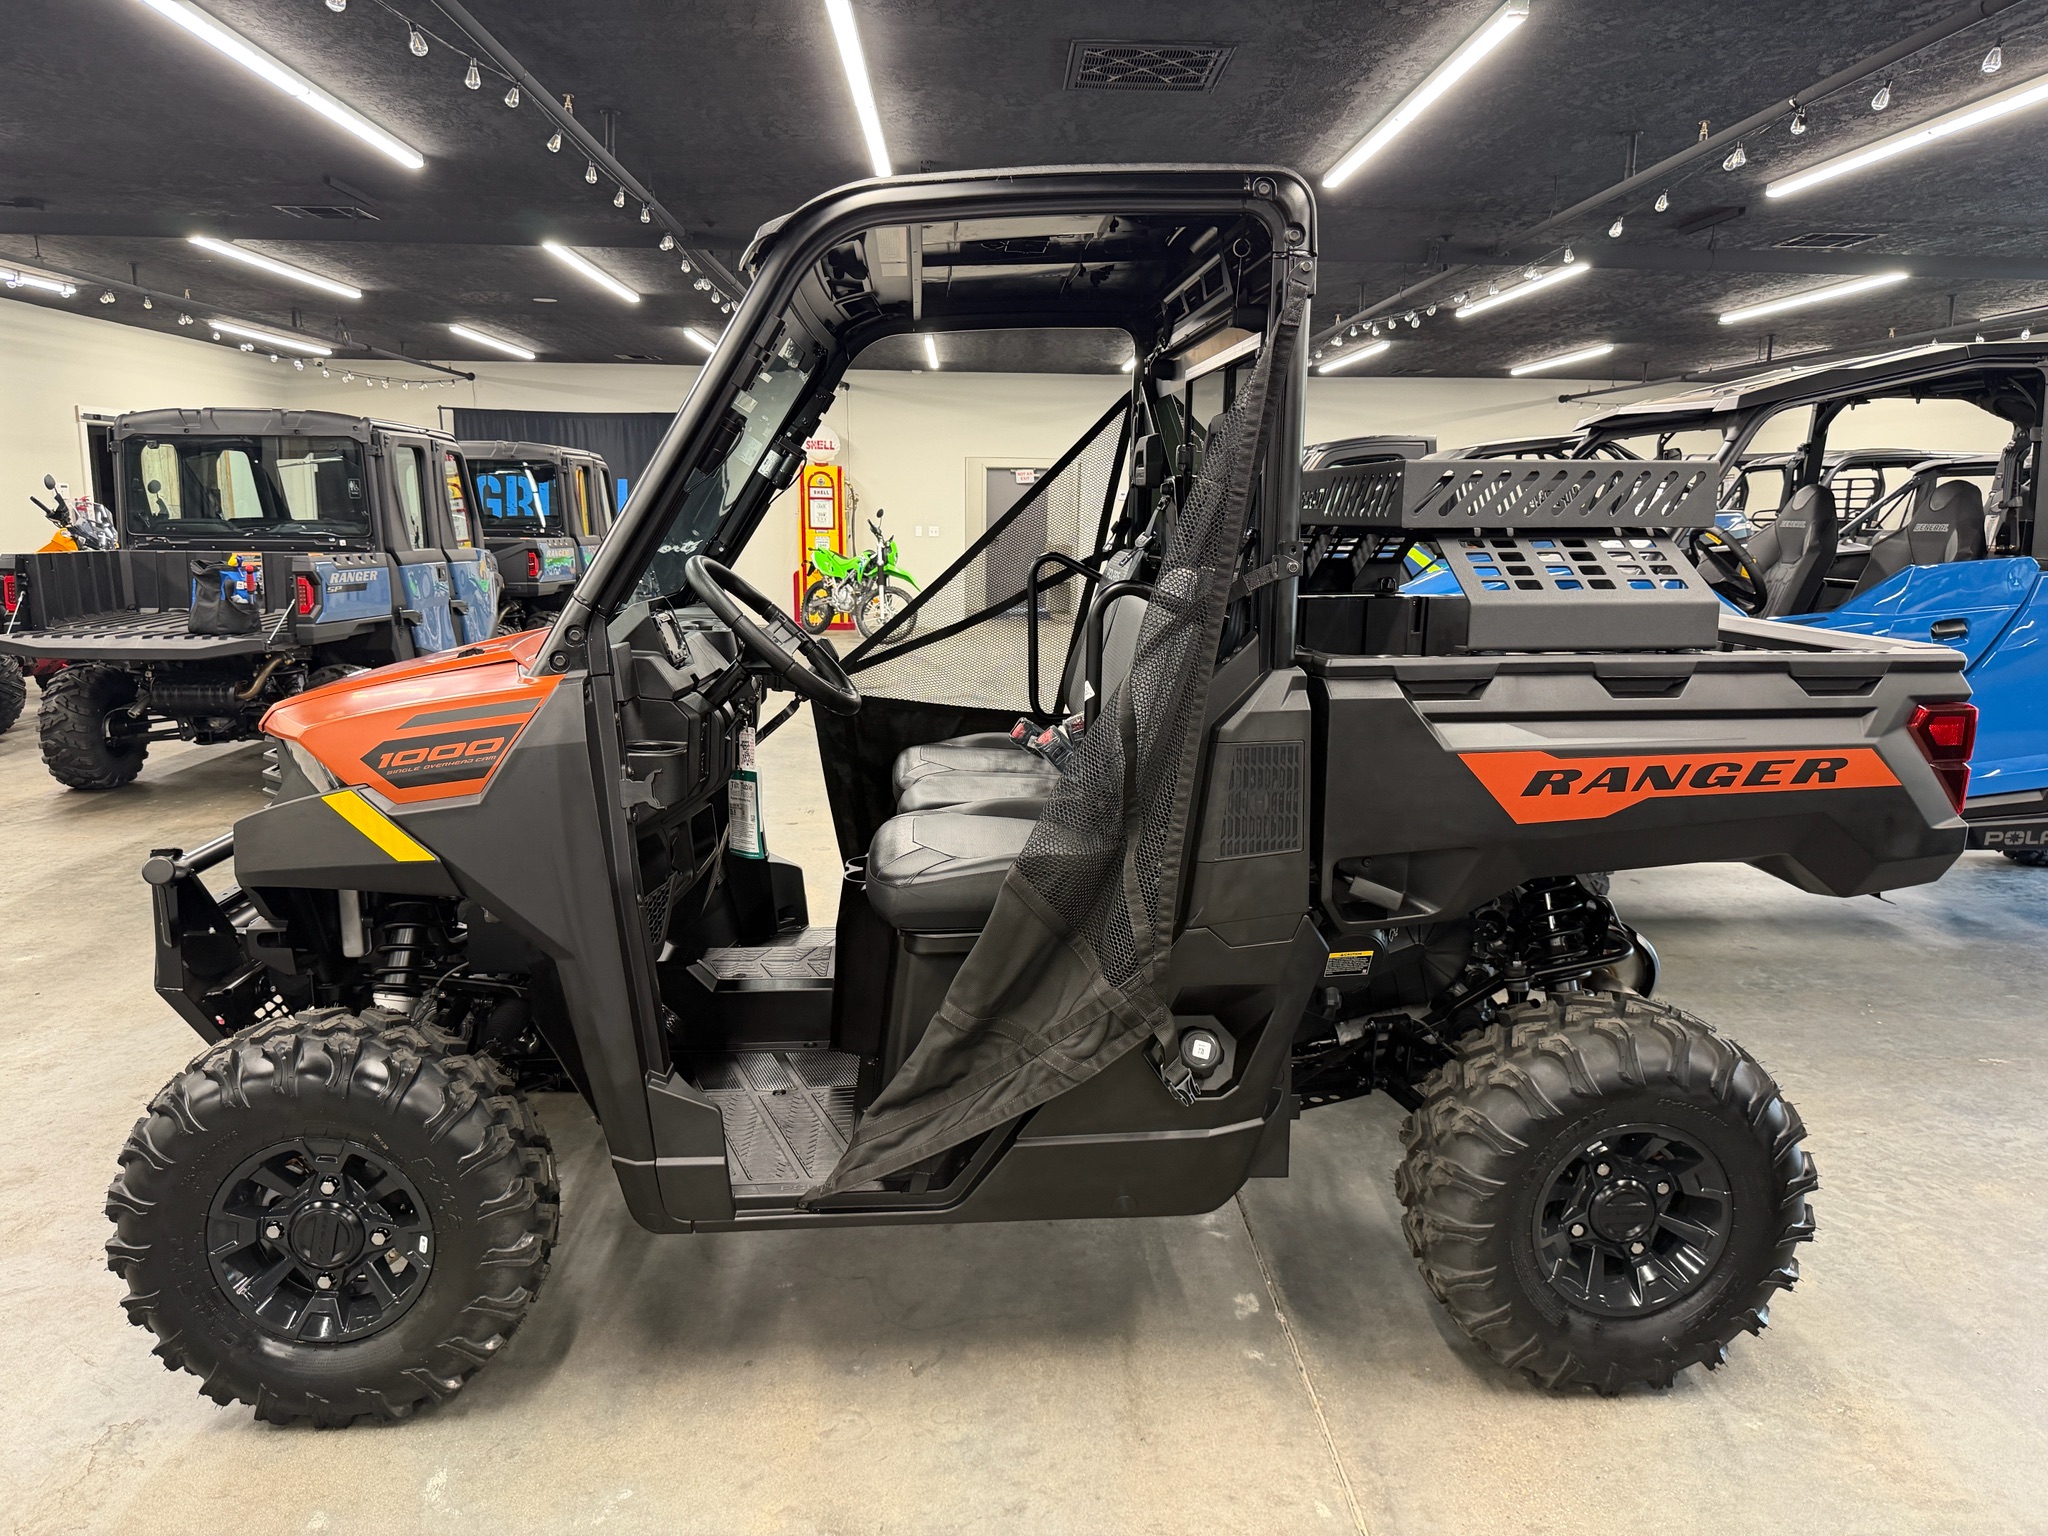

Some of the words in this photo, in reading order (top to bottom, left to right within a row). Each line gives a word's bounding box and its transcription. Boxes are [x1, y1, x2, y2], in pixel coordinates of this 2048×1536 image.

[805, 440, 835, 450] SHELL
[1913, 523, 1950, 532] GENERAL
[329, 570, 378, 584] RANGER
[327, 585, 343, 593] SP
[378, 737, 505, 769] 1000
[386, 765, 421, 776] SINGLE
[423, 758, 474, 770] OVERHEAD
[475, 755, 497, 763] CAM
[1520, 757, 1849, 797] RANGER
